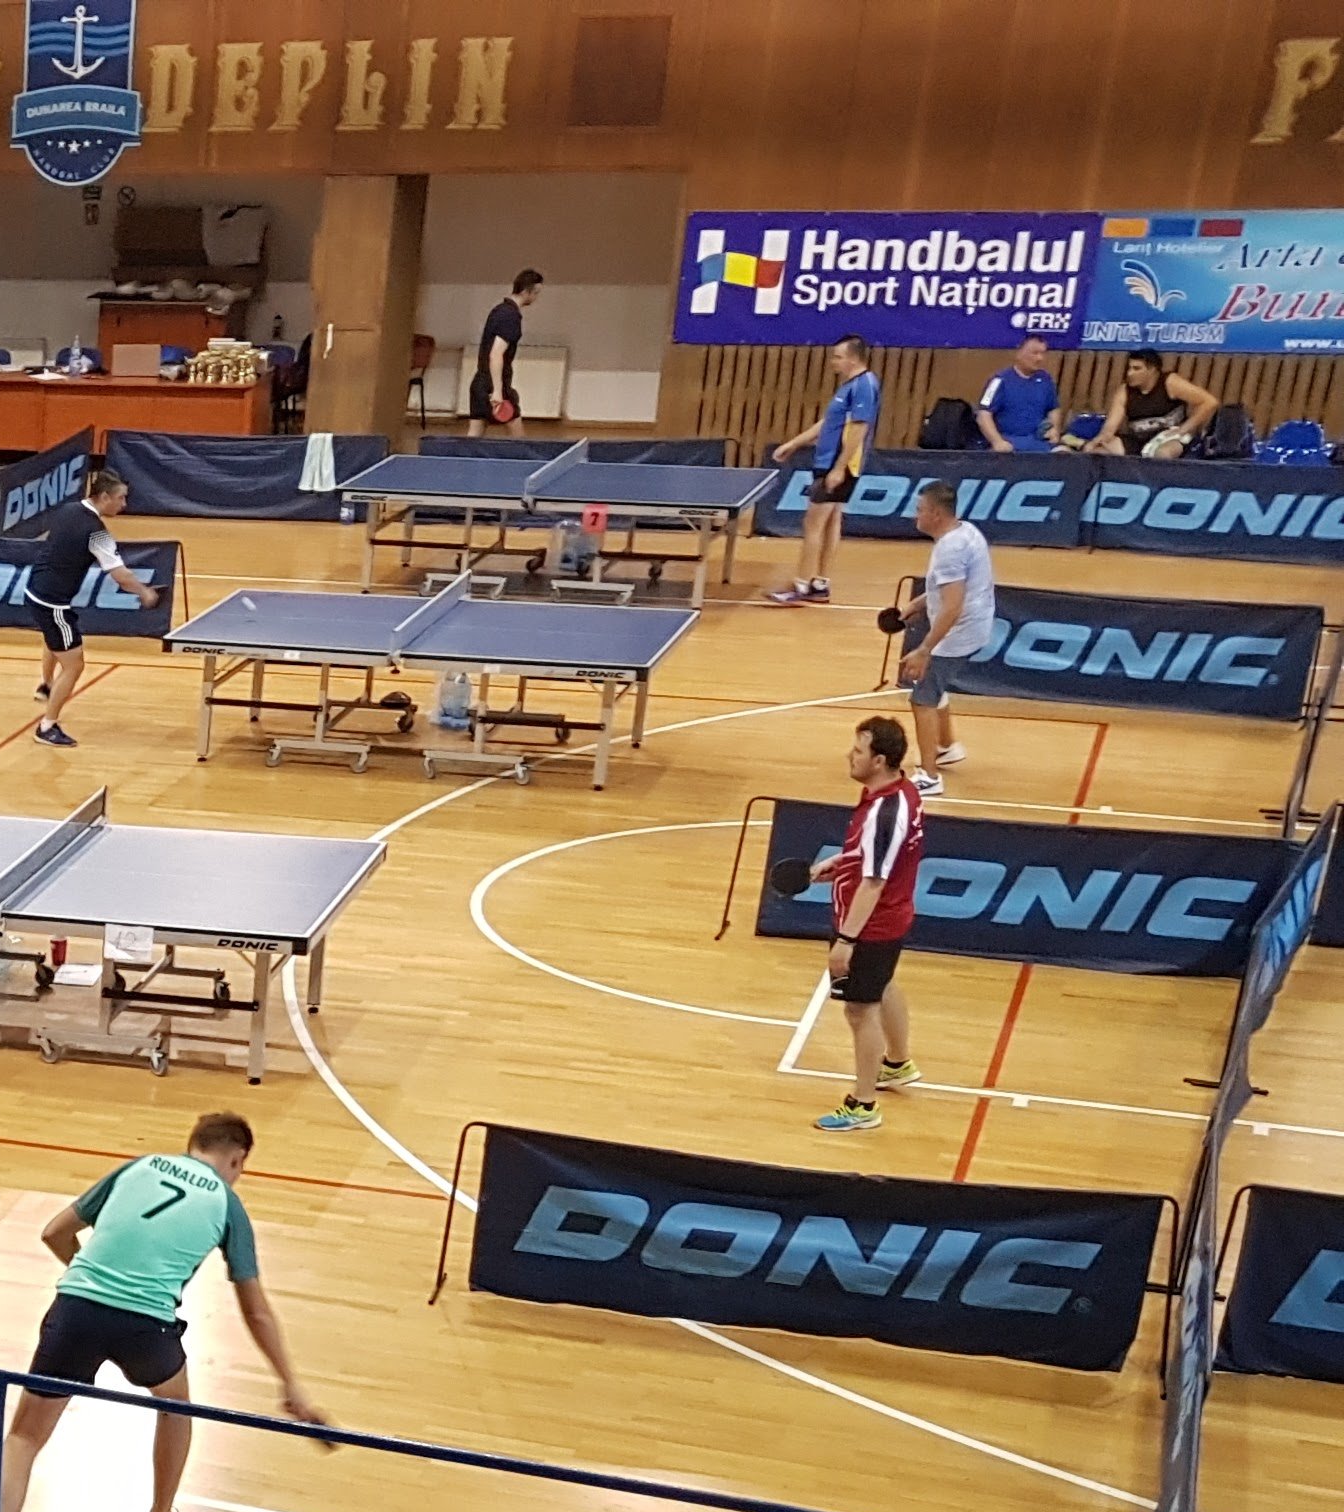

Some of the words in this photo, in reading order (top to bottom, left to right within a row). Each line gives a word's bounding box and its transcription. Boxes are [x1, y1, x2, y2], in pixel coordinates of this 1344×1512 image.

[142, 36, 515, 133] DEPLIN
[25, 101, 82, 118] DUNAREA
[84, 100, 127, 116] BRAILA
[799, 229, 1086, 273] Handbalul
[792, 274, 900, 311] Sport
[1082, 322, 1142, 342] UNITA
[1145, 323, 1227, 344] TURISM
[3, 454, 87, 531] DONIC
[181, 645, 226, 656] DONIC
[575, 669, 627, 680] DONIC
[217, 938, 279, 952] DONIC
[149, 1155, 220, 1193] RONALDO
[141, 1180, 187, 1220] 7
[513, 1185, 1104, 1317] DONIC
